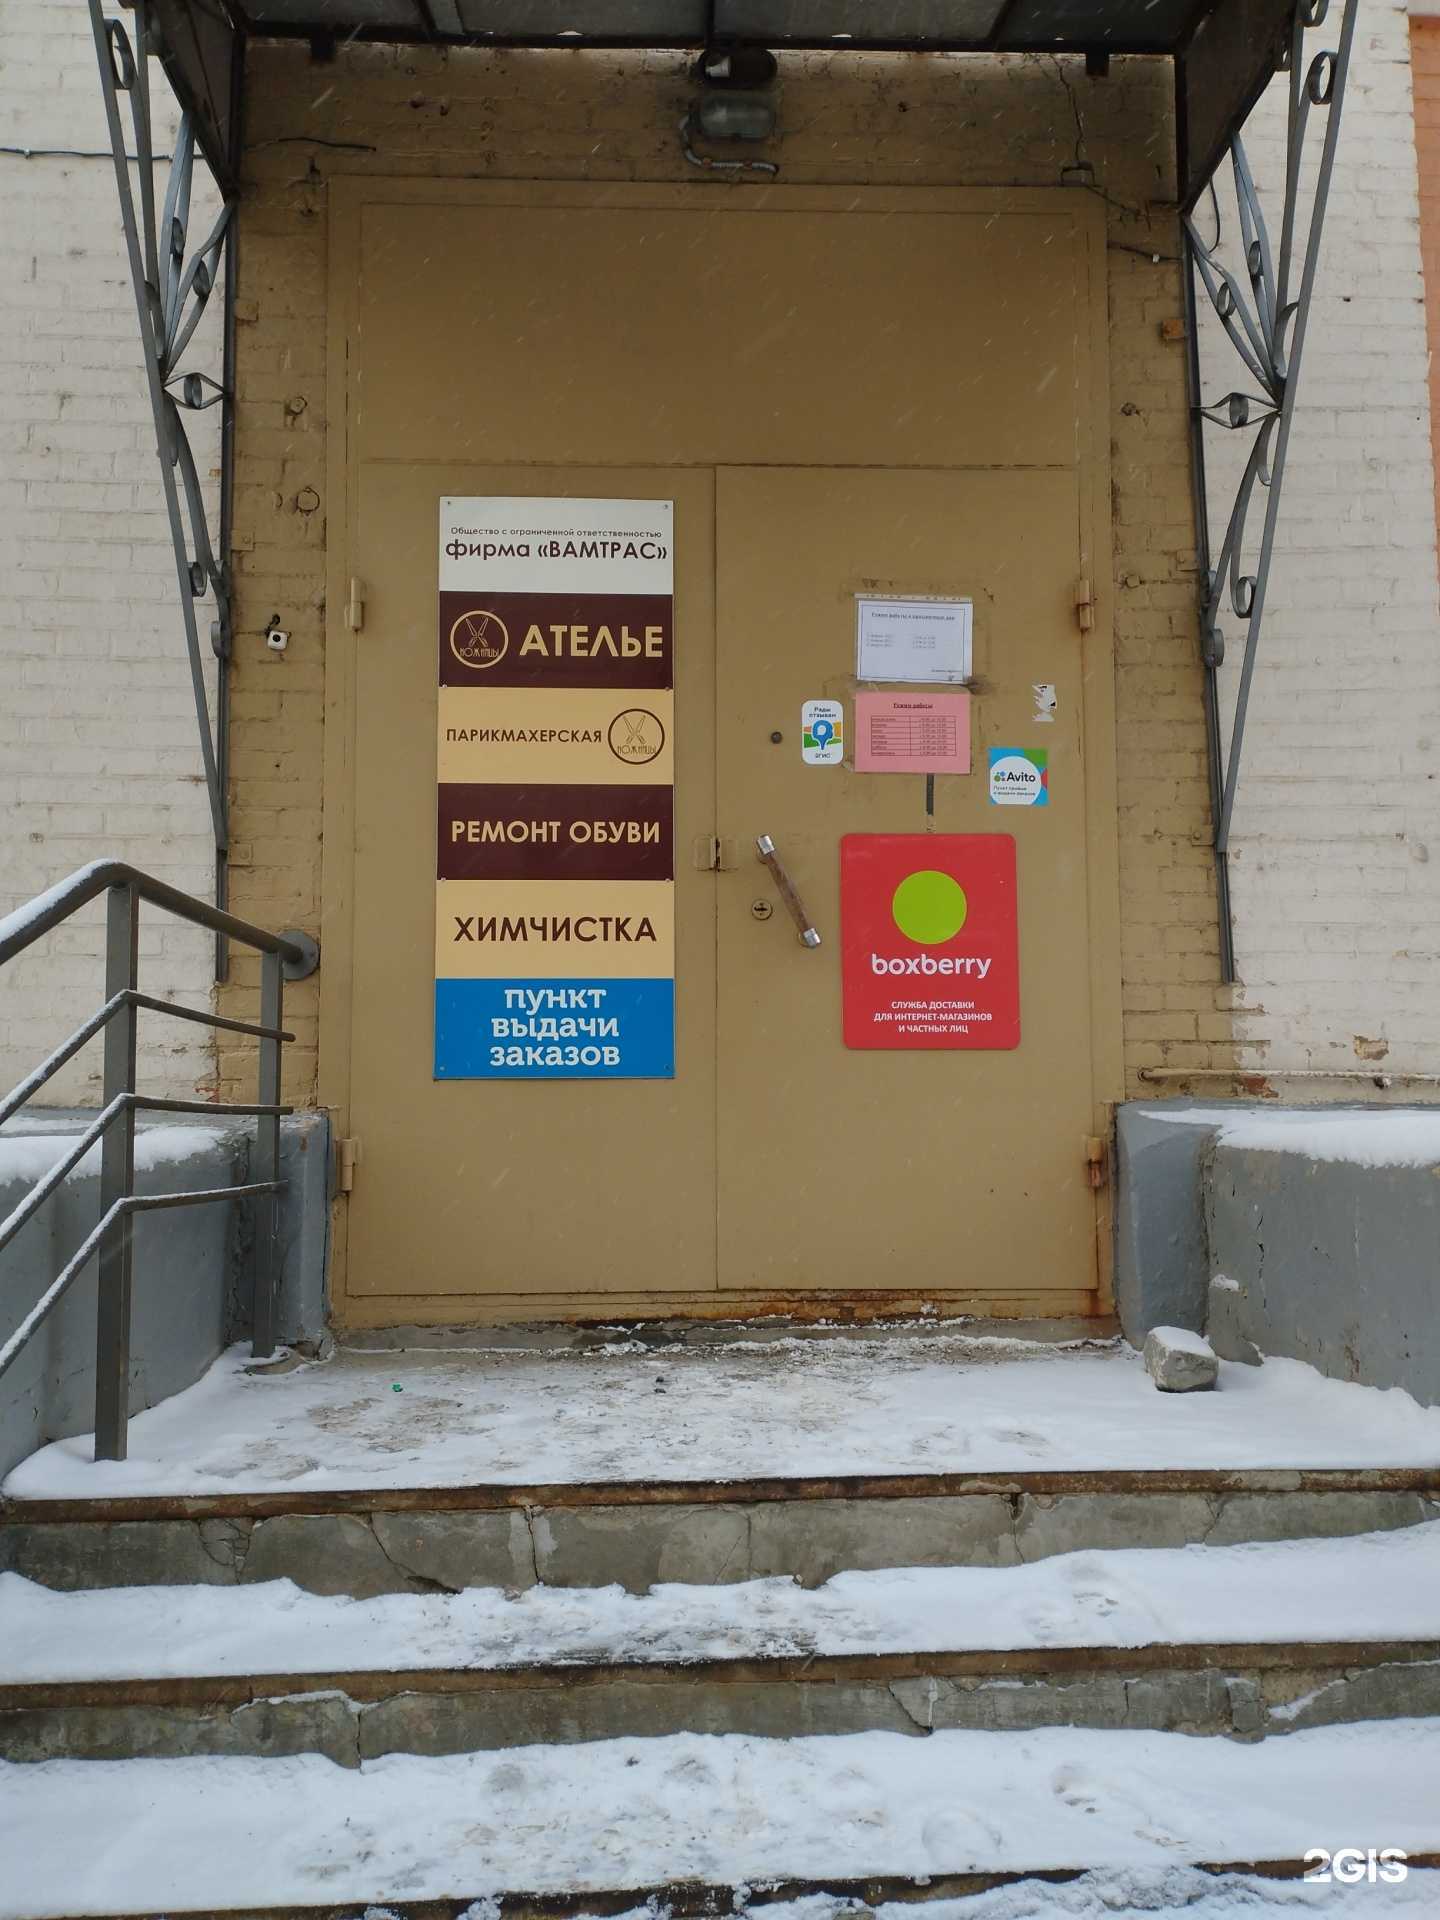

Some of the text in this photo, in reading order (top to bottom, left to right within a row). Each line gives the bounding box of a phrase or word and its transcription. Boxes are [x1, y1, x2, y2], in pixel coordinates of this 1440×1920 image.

[450, 526, 499, 536] Общество
[510, 528, 574, 537] ограниченной
[576, 530, 662, 538] ответственностью
[446, 539, 668, 560] фирма «ВАМТРАС»
[519, 624, 663, 658] АТЕЛЬЕ
[446, 728, 602, 742] ПАРИКМАХЕРСКАЯ
[1006, 772, 1036, 782] Avito
[452, 820, 660, 844] РЕМОНТ ОБУВИ
[453, 916, 657, 942] ХИМЧИСТКА
[872, 954, 992, 979] boxberry
[504, 988, 607, 1016] пункт
[891, 1001, 974, 1010] СЛУЖБА ДОСТАВКИ
[874, 1012, 993, 1022] ДЛЯ ИНТЕРНЕТ-МАГАЗИНОВ
[491, 1017, 620, 1041] выдачи
[949, 1024, 968, 1034] ЛИЦ
[490, 1046, 621, 1066] заказов
